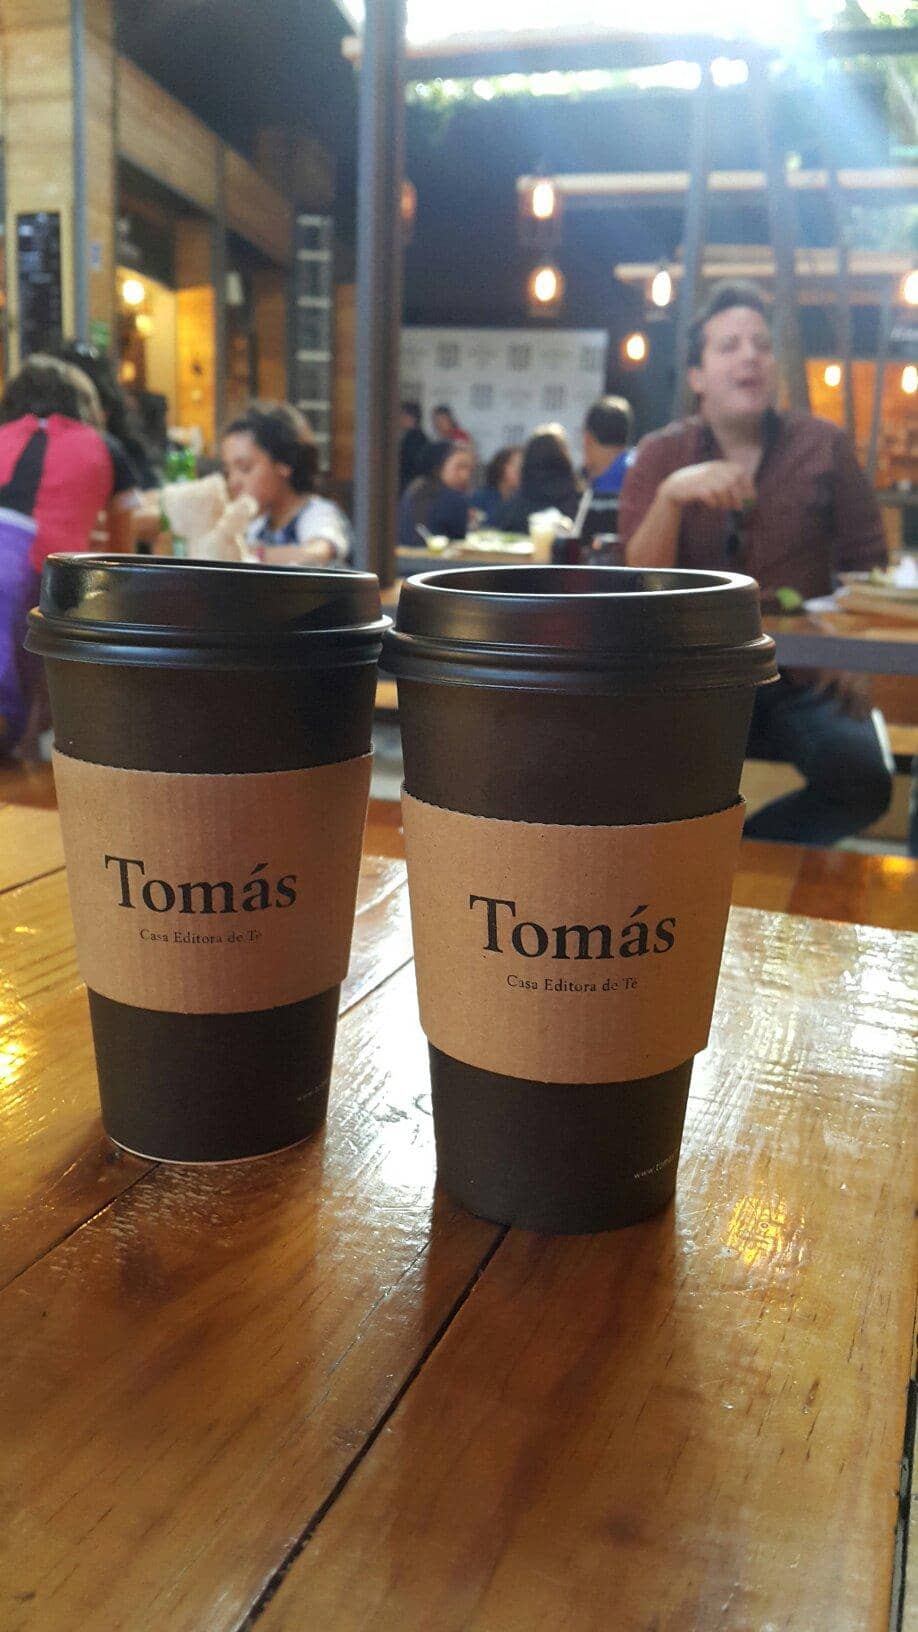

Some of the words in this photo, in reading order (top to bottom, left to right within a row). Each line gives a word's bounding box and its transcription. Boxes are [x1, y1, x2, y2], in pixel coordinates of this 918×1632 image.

[104, 854, 297, 914] Tomás
[139, 928, 169, 942] Casa
[174, 931, 222, 944] Editora
[227, 931, 243, 942] de
[469, 894, 676, 960] Tomás
[506, 974, 538, 990] Casa
[544, 978, 597, 992] Editora
[602, 978, 618, 992] de
[623, 977, 639, 989] Té
